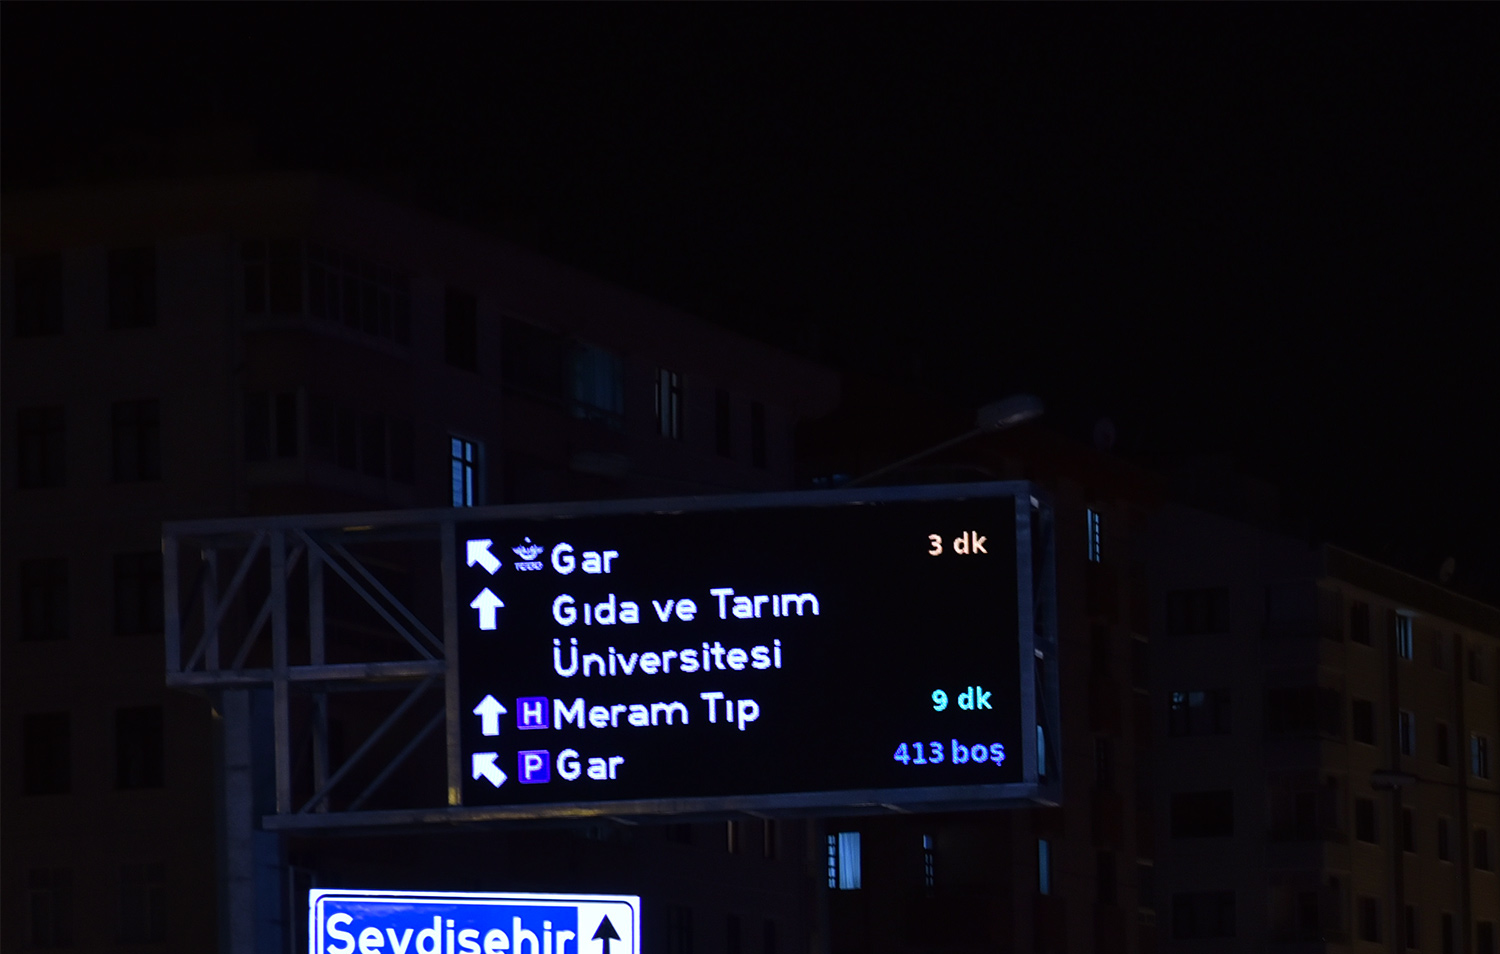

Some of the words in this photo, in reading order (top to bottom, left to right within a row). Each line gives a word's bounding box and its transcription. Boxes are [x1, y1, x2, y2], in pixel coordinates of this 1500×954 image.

[551, 542, 619, 574] Gar
[928, 534, 942, 556] 3
[953, 531, 988, 556] dk
[552, 594, 640, 627] Gıda
[652, 597, 697, 622] ve
[710, 588, 819, 620] Tarım
[552, 638, 782, 678] Üniversitesi
[523, 702, 542, 725] H
[553, 698, 688, 730] Meram
[701, 692, 760, 730] Tıp
[932, 689, 947, 711] 9
[958, 687, 992, 711] dk
[556, 749, 625, 781] Gar
[894, 742, 944, 765] 413
[952, 741, 1005, 766] boş
